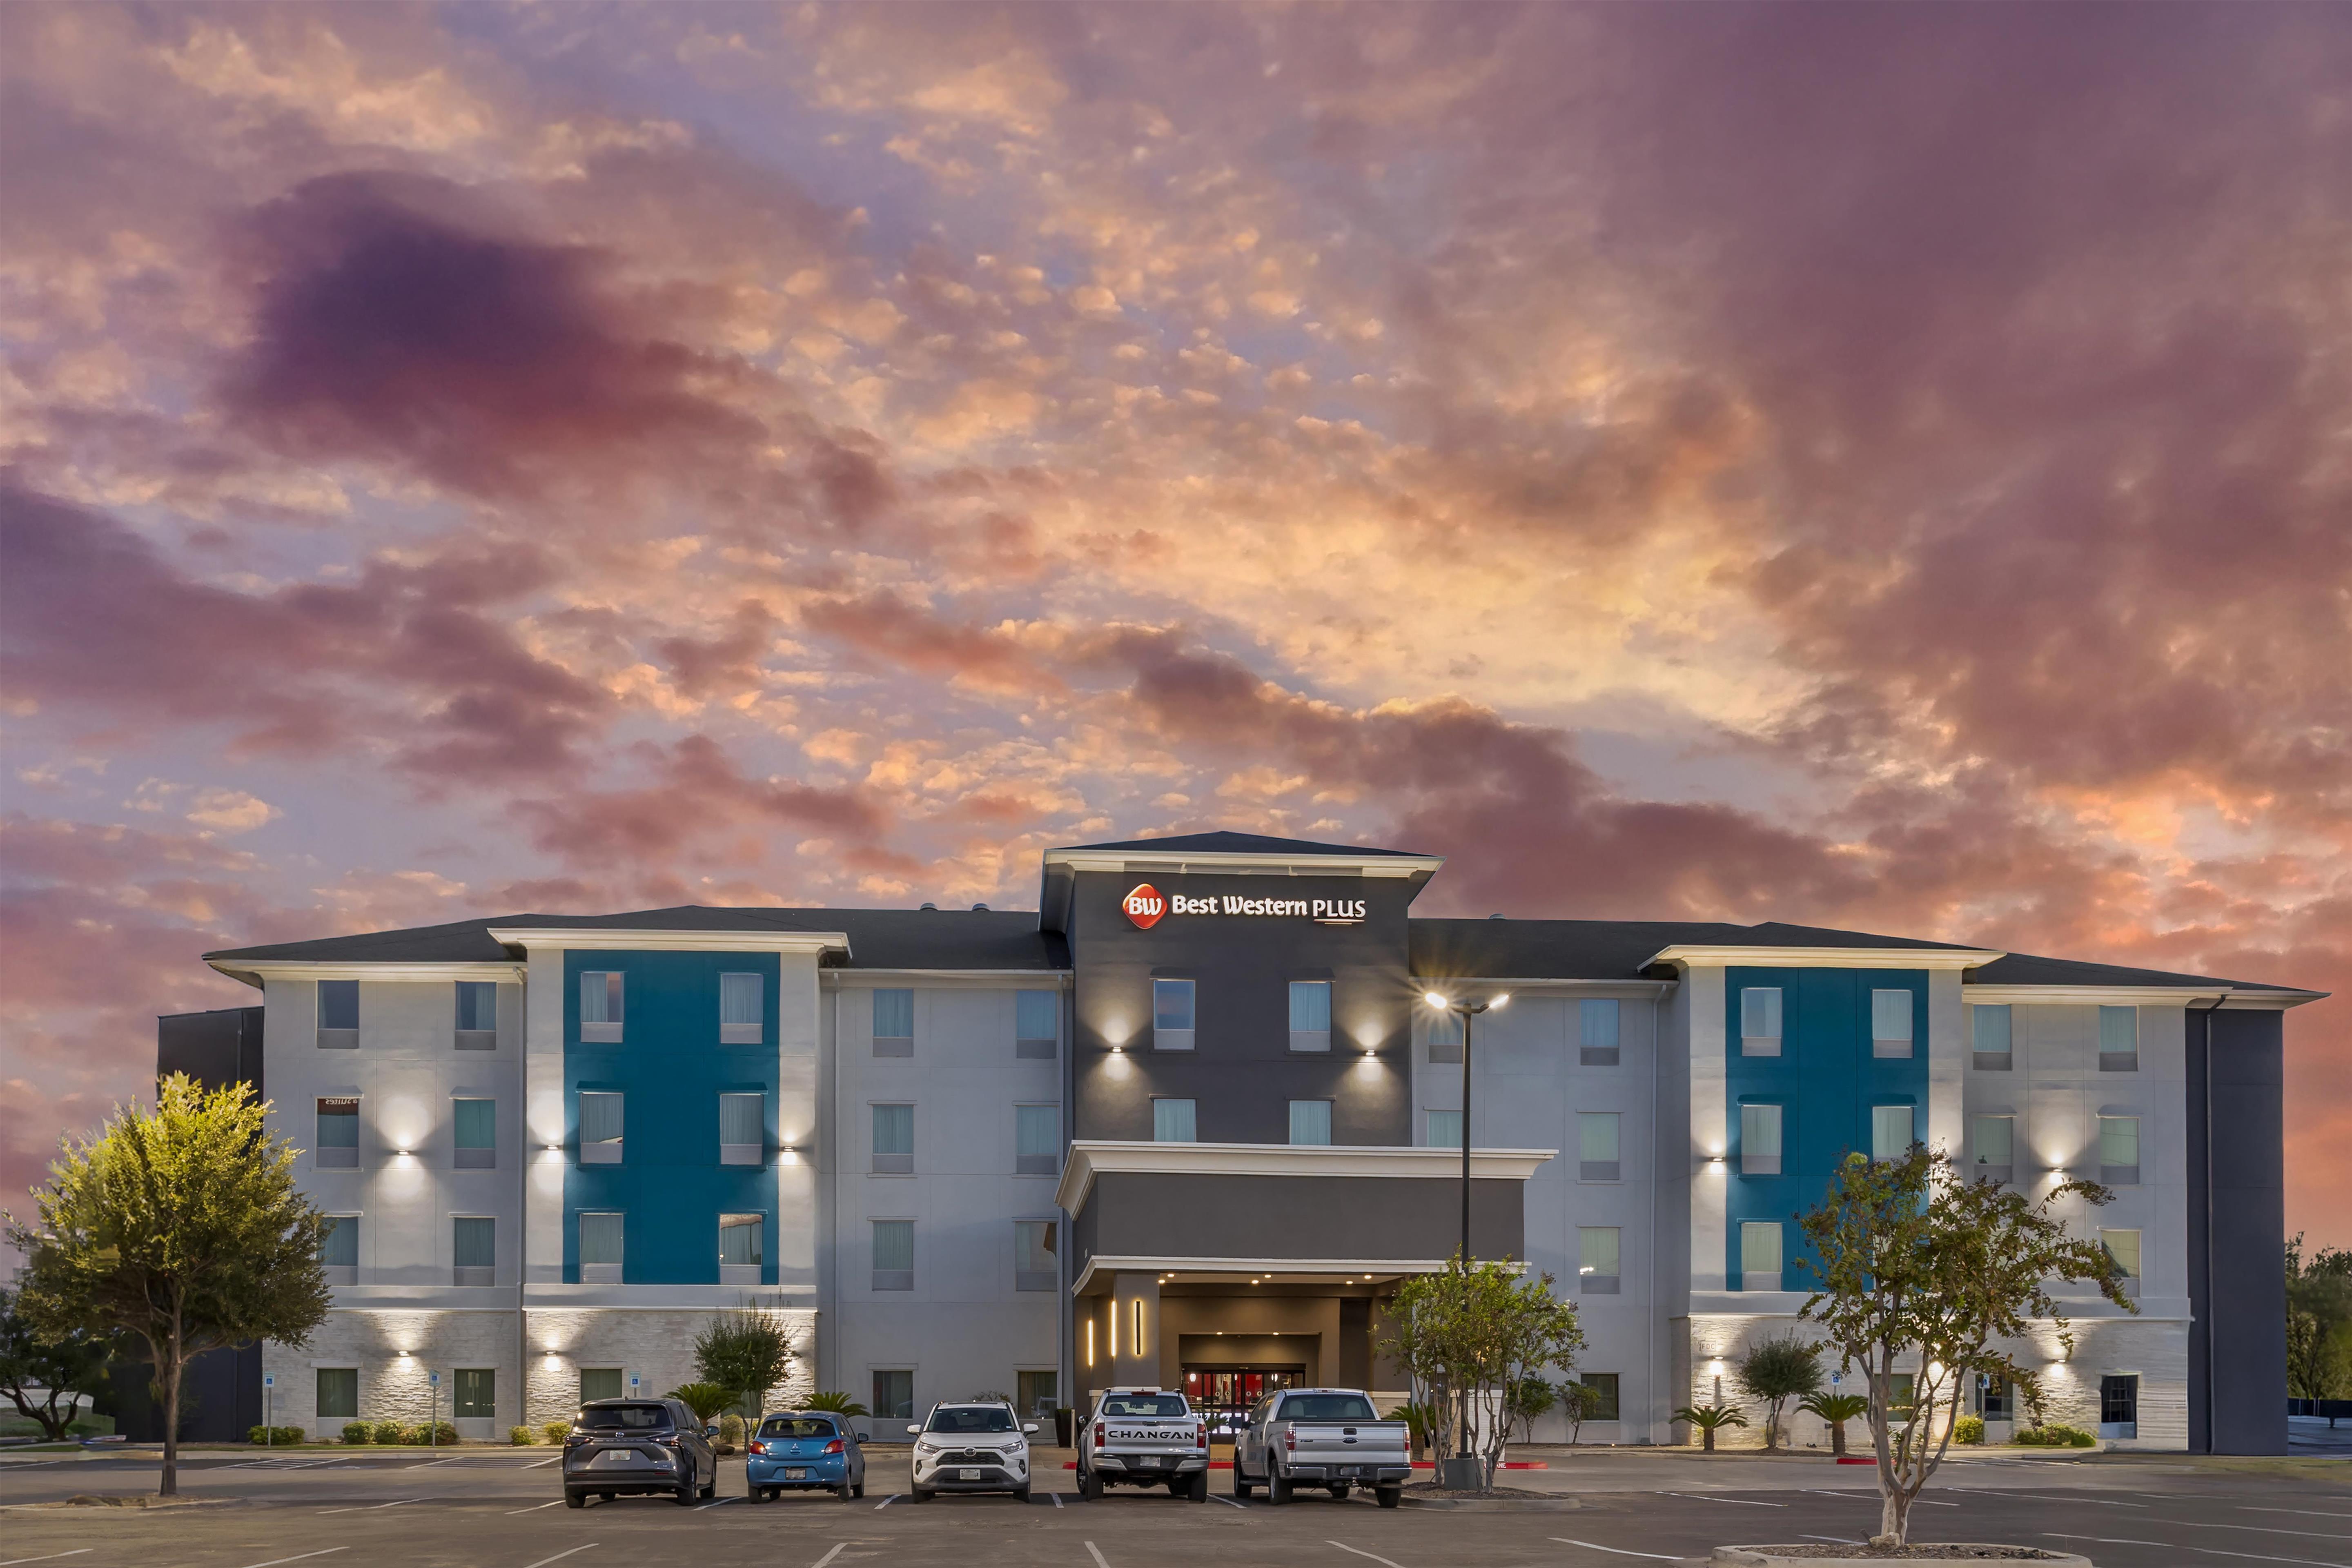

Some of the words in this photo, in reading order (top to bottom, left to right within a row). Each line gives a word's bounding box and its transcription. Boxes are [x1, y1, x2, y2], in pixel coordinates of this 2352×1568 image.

[1129, 897, 1161, 915] BW
[1172, 895, 1218, 914] Best
[1223, 896, 1307, 916] Western
[1313, 900, 1366, 917] PLUS
[1108, 1431, 1194, 1439] CHANGAN
